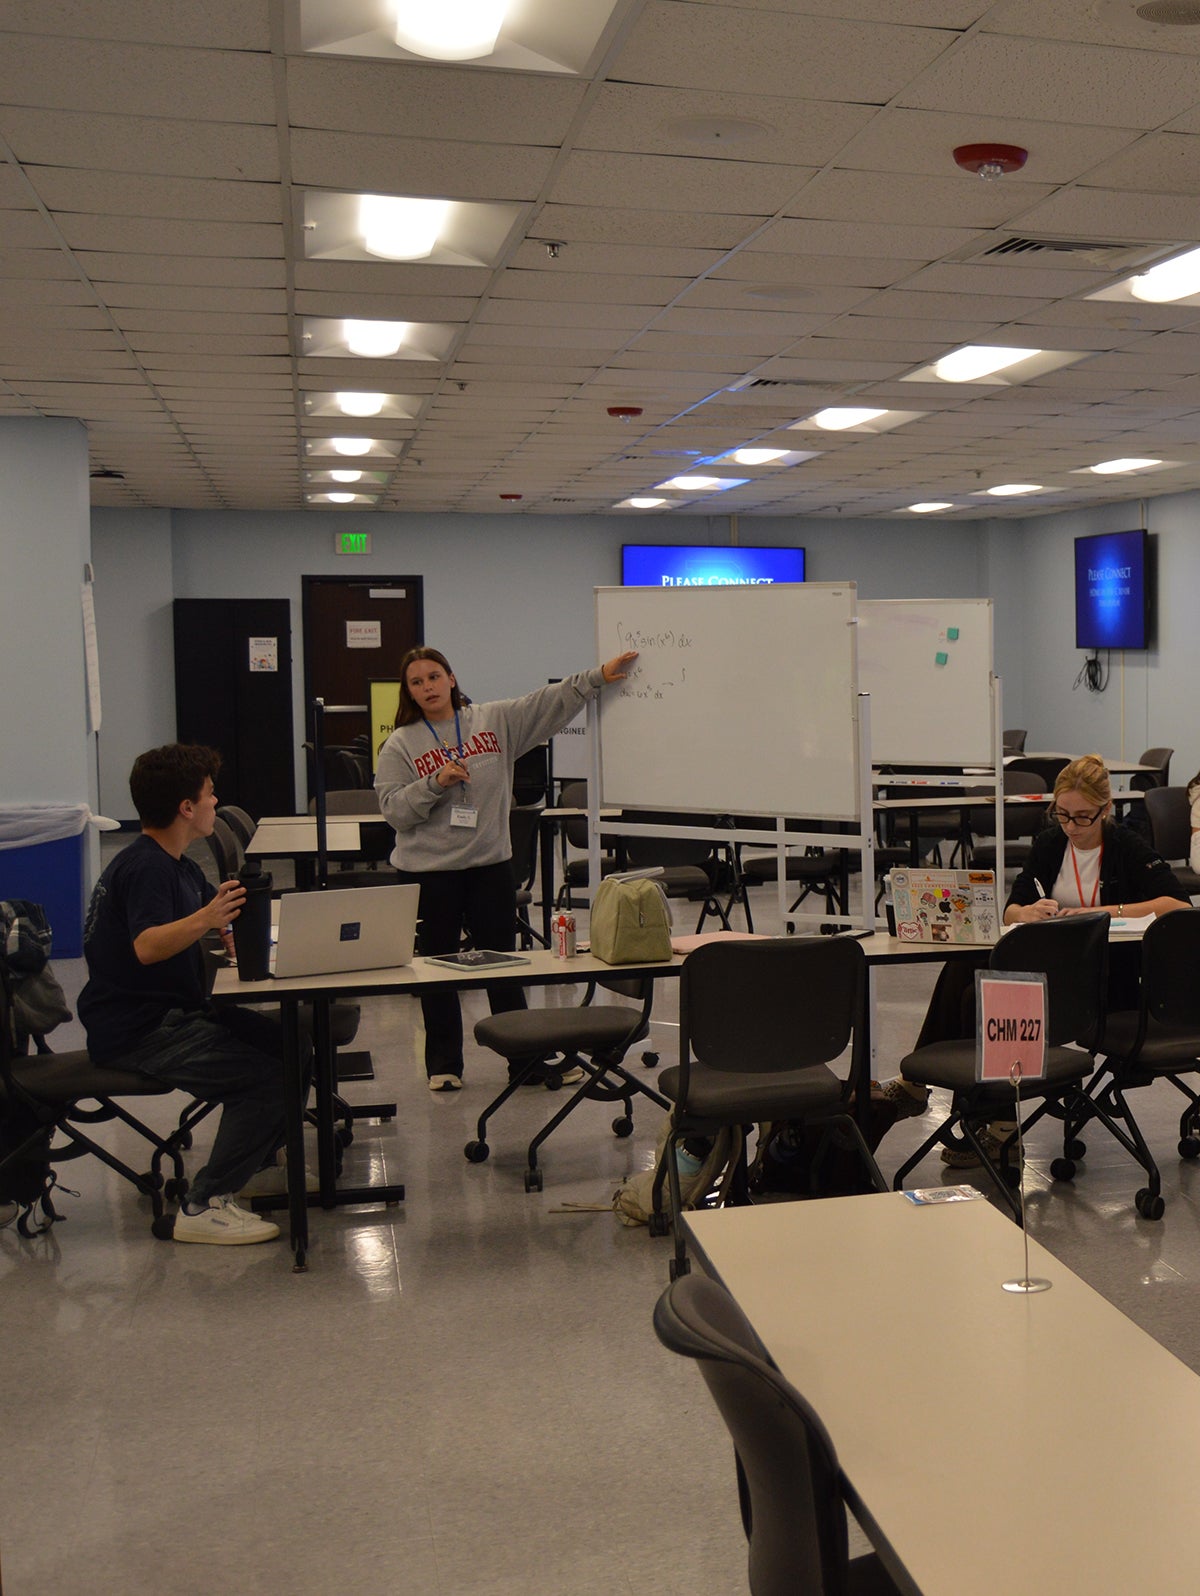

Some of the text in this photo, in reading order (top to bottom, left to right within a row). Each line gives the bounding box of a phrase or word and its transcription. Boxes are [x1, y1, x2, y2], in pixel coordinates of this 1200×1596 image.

[341, 533, 367, 553] EXIT
[380, 725, 395, 733] PH
[987, 1018, 1042, 1042] CHM 227
